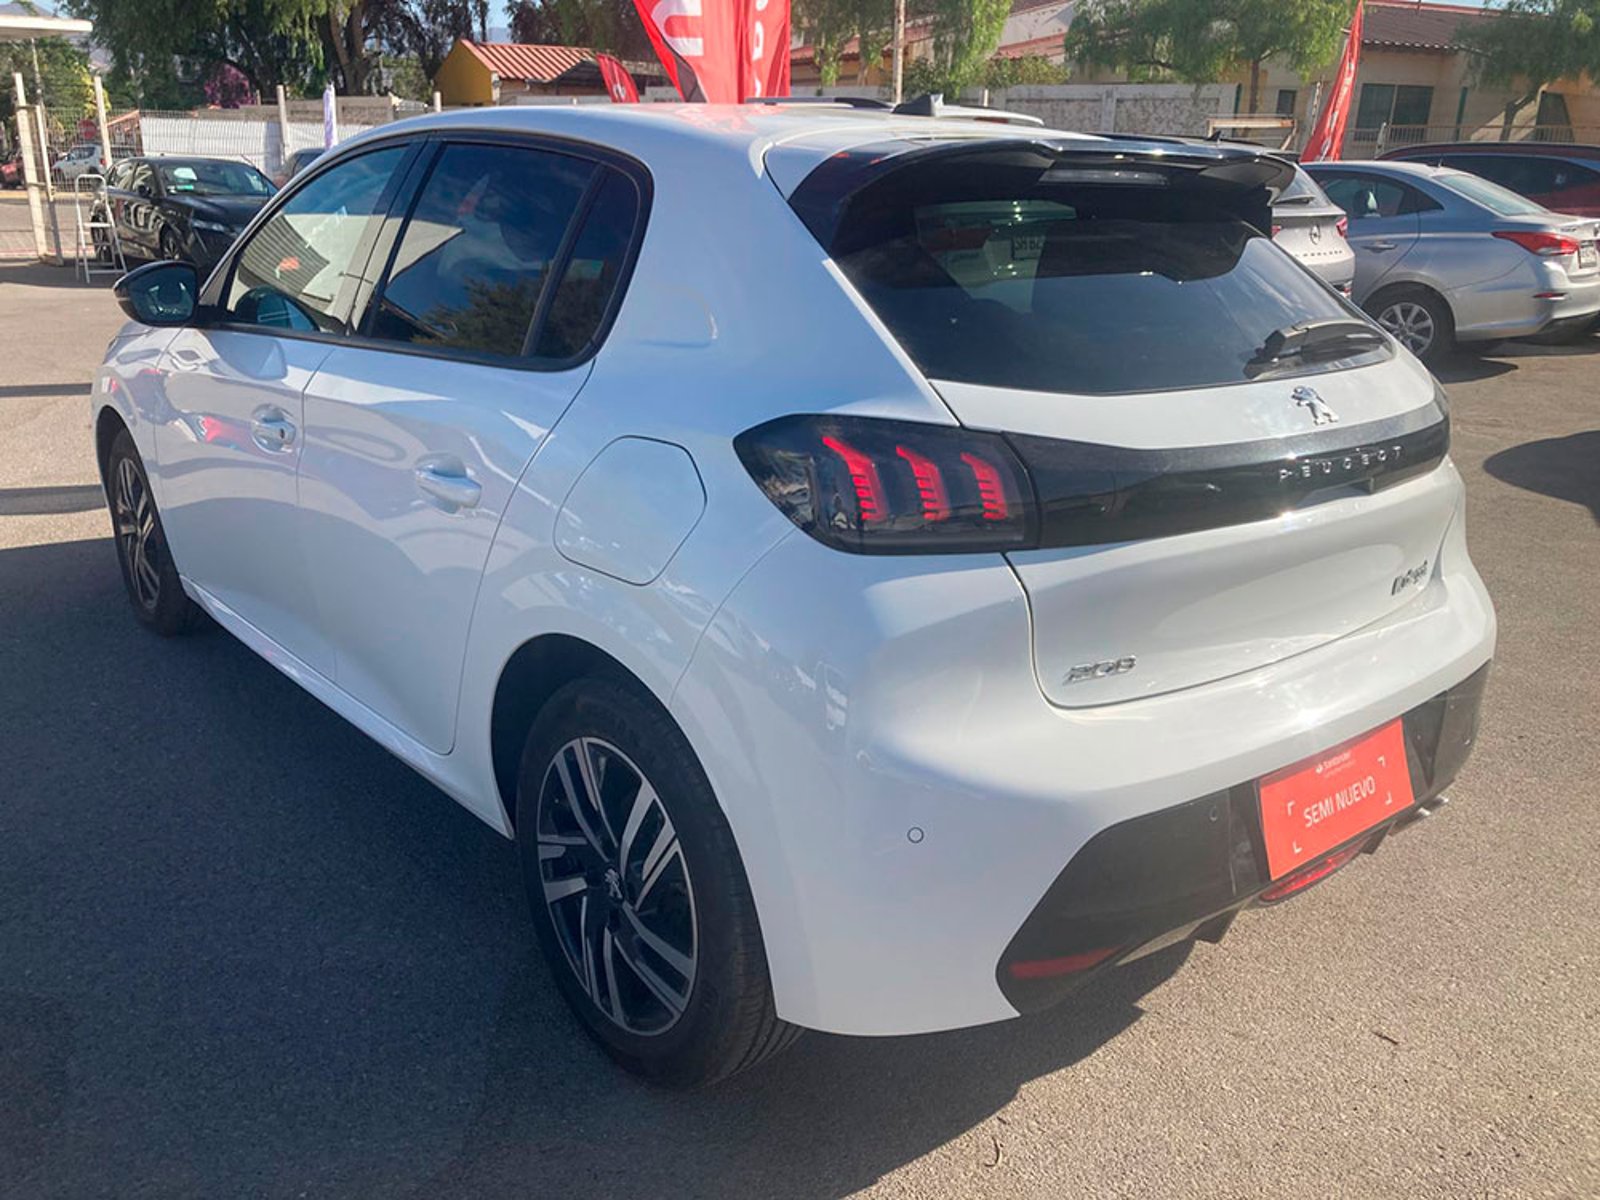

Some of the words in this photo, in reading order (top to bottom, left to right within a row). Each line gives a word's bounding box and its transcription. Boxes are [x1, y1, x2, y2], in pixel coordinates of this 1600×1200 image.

[1279, 445, 1402, 480] PEUGEOT
[1303, 795, 1335, 828] SEMI
[1335, 775, 1377, 812] NUEVO
